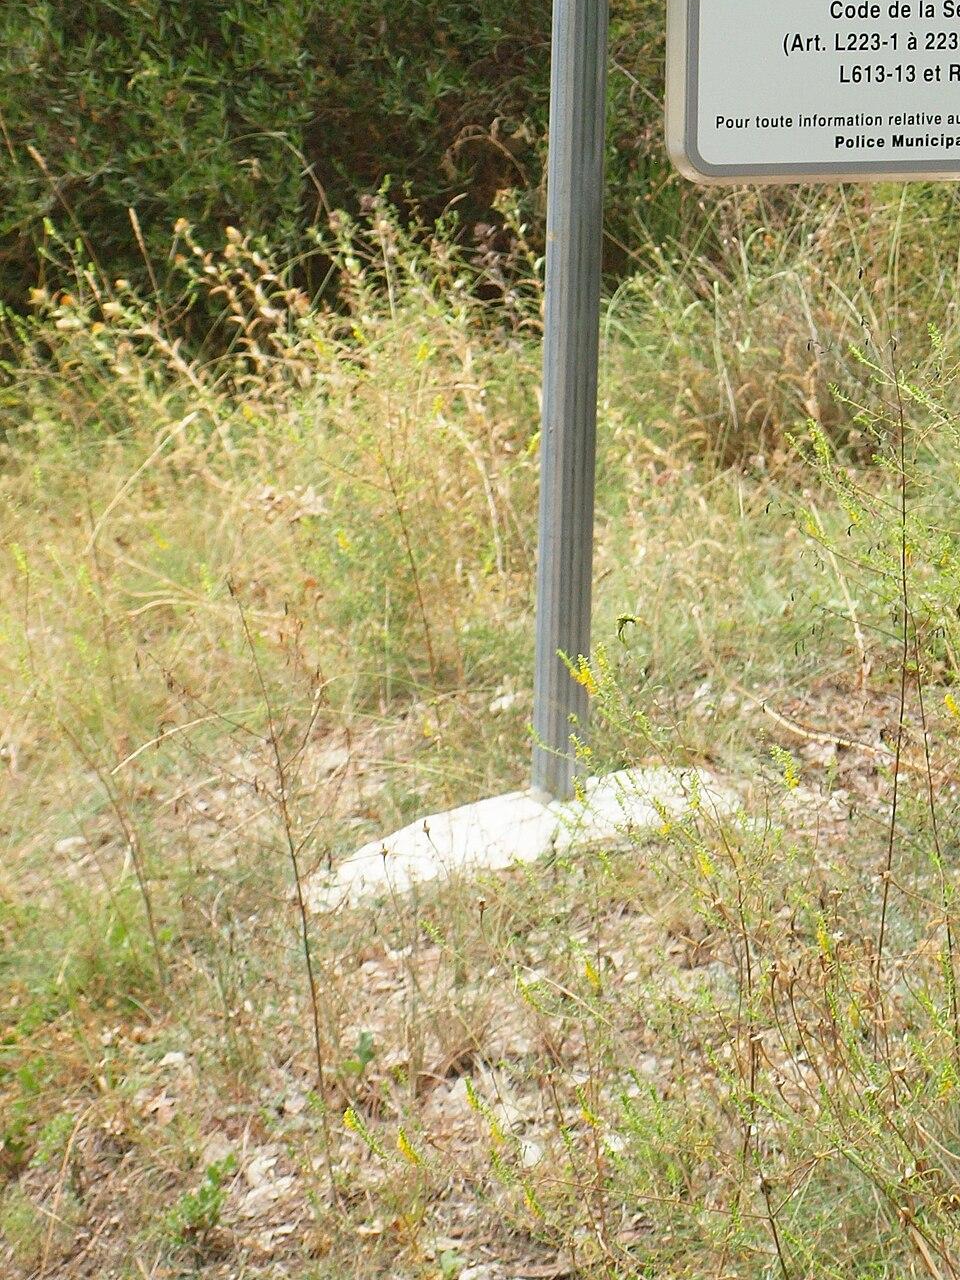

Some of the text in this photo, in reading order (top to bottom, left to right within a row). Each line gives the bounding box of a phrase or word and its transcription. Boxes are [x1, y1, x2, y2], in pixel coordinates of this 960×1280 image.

[830, 0, 881, 20] Code
[888, 0, 911, 19] de
[919, 0, 935, 19] la
[783, 33, 826, 57] (Art.
[835, 32, 898, 51] L223-1
[907, 31, 917, 51] à
[839, 64, 916, 84] L613-13
[923, 64, 941, 83] et
[716, 115, 751, 129] Pour
[755, 115, 793, 129] toute
[798, 112, 883, 128] information
[888, 111, 942, 126] relative
[835, 134, 885, 149] Police
